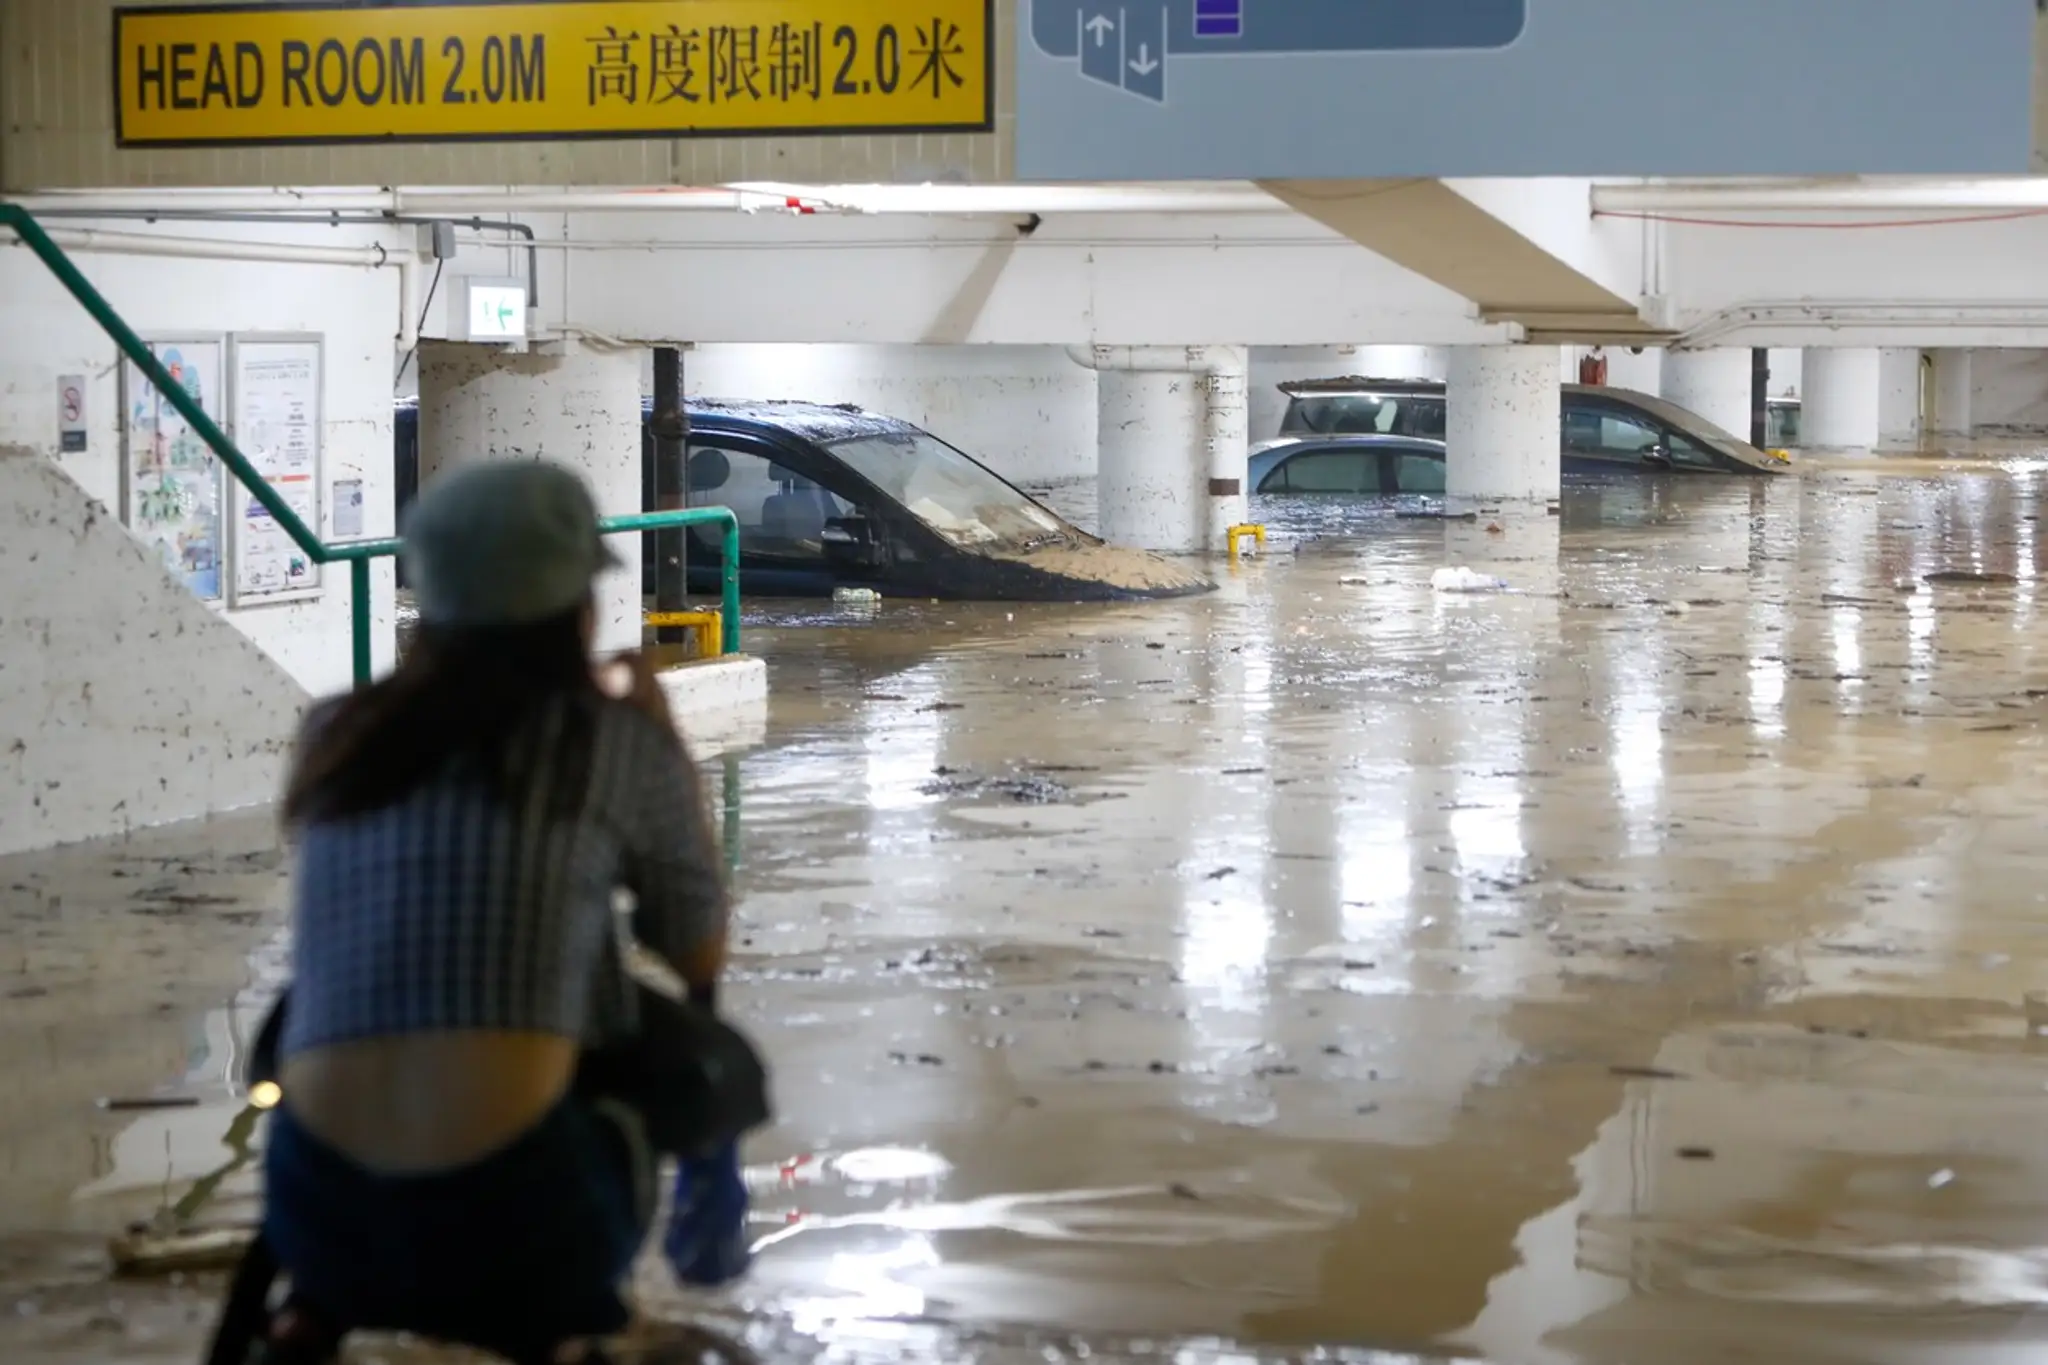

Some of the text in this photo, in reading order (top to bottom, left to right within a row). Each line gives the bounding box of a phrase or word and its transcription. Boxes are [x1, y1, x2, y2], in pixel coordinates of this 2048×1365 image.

[136, 34, 545, 111] HEAD ROOM 2.0M
[585, 17, 965, 106] 高度限制2.0米
